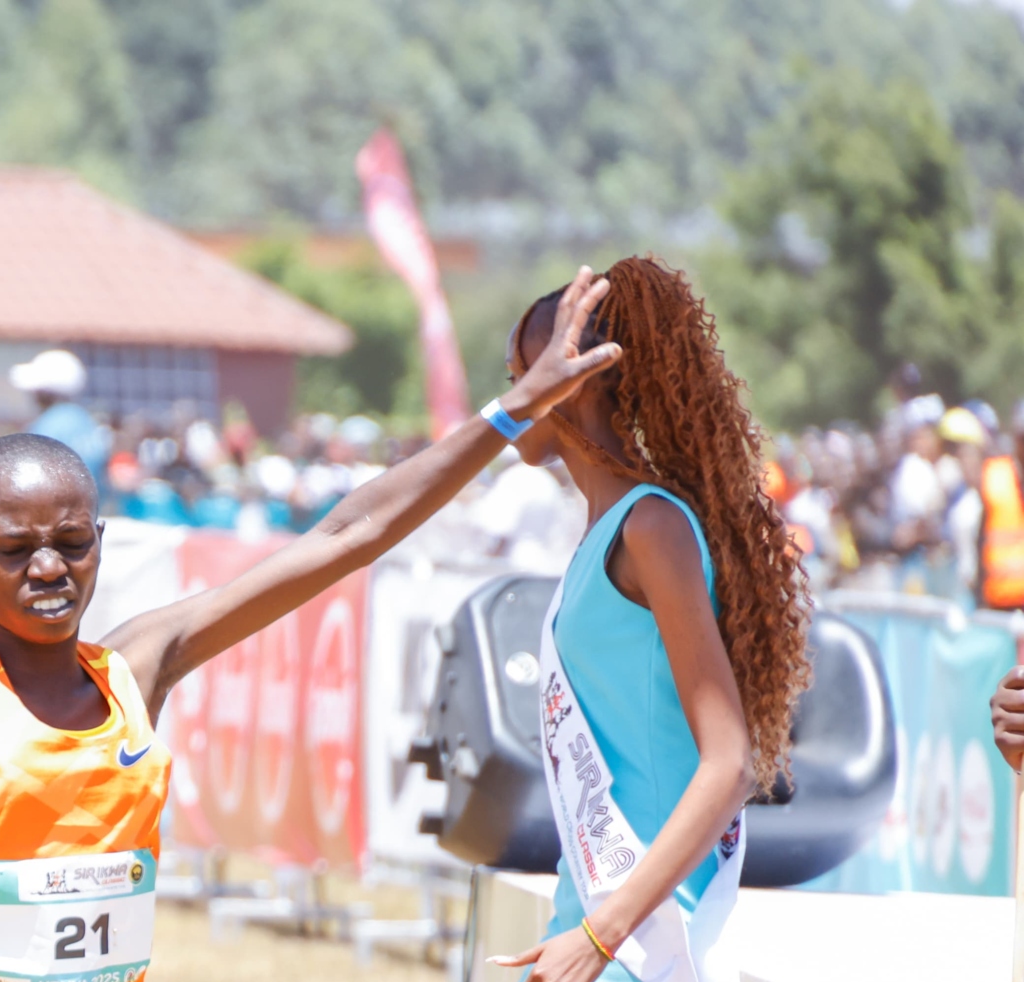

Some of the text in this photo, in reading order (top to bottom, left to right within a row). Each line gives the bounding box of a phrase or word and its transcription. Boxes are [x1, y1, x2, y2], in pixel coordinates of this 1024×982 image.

[73, 863, 128, 885] SIRIKWA
[576, 823, 602, 888] CLASSIC
[54, 912, 110, 960] 21
